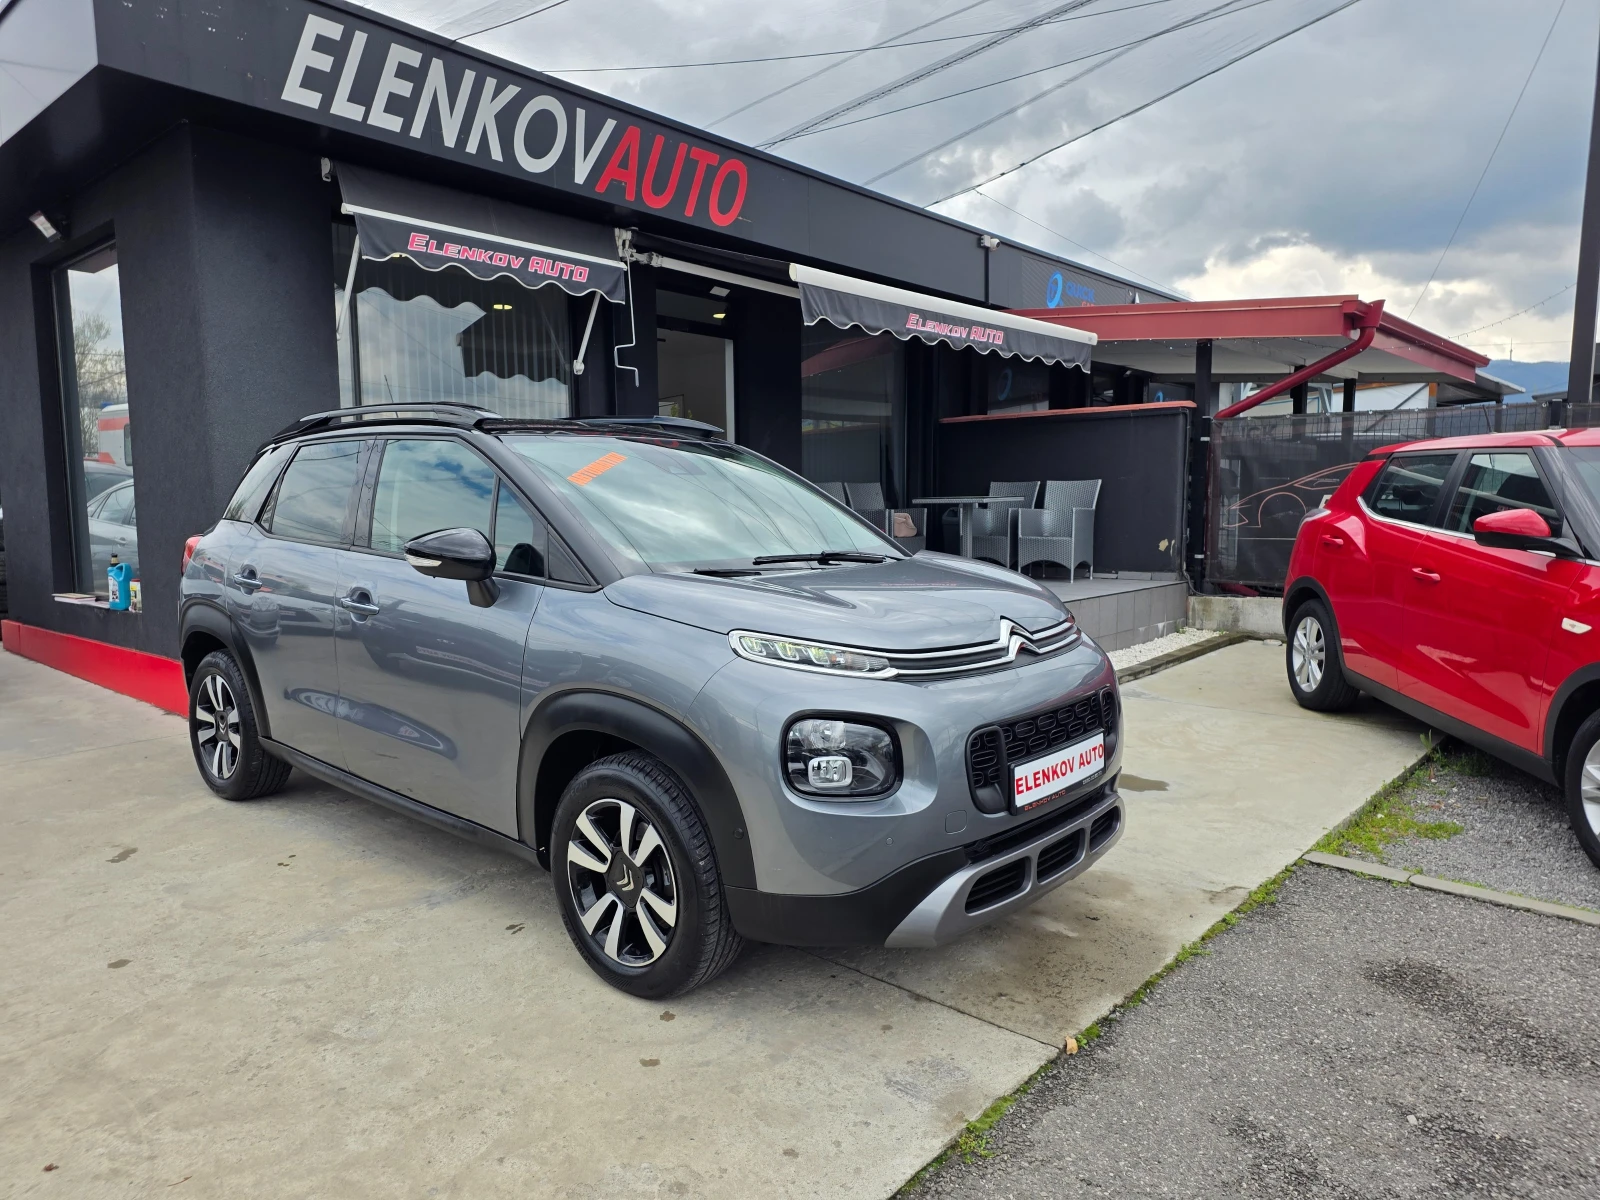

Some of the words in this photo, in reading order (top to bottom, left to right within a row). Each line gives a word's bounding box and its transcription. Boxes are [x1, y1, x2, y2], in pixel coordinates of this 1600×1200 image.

[407, 232, 525, 269] ELENKOV
[528, 256, 590, 283] AUTO
[1066, 281, 1095, 303] QUICK
[905, 312, 969, 339] ELENKOV
[970, 325, 1004, 345] AUTO
[1015, 757, 1075, 796] ELENKOV
[1078, 743, 1104, 770] AUTO
[1051, 789, 1066, 800] AUTO
